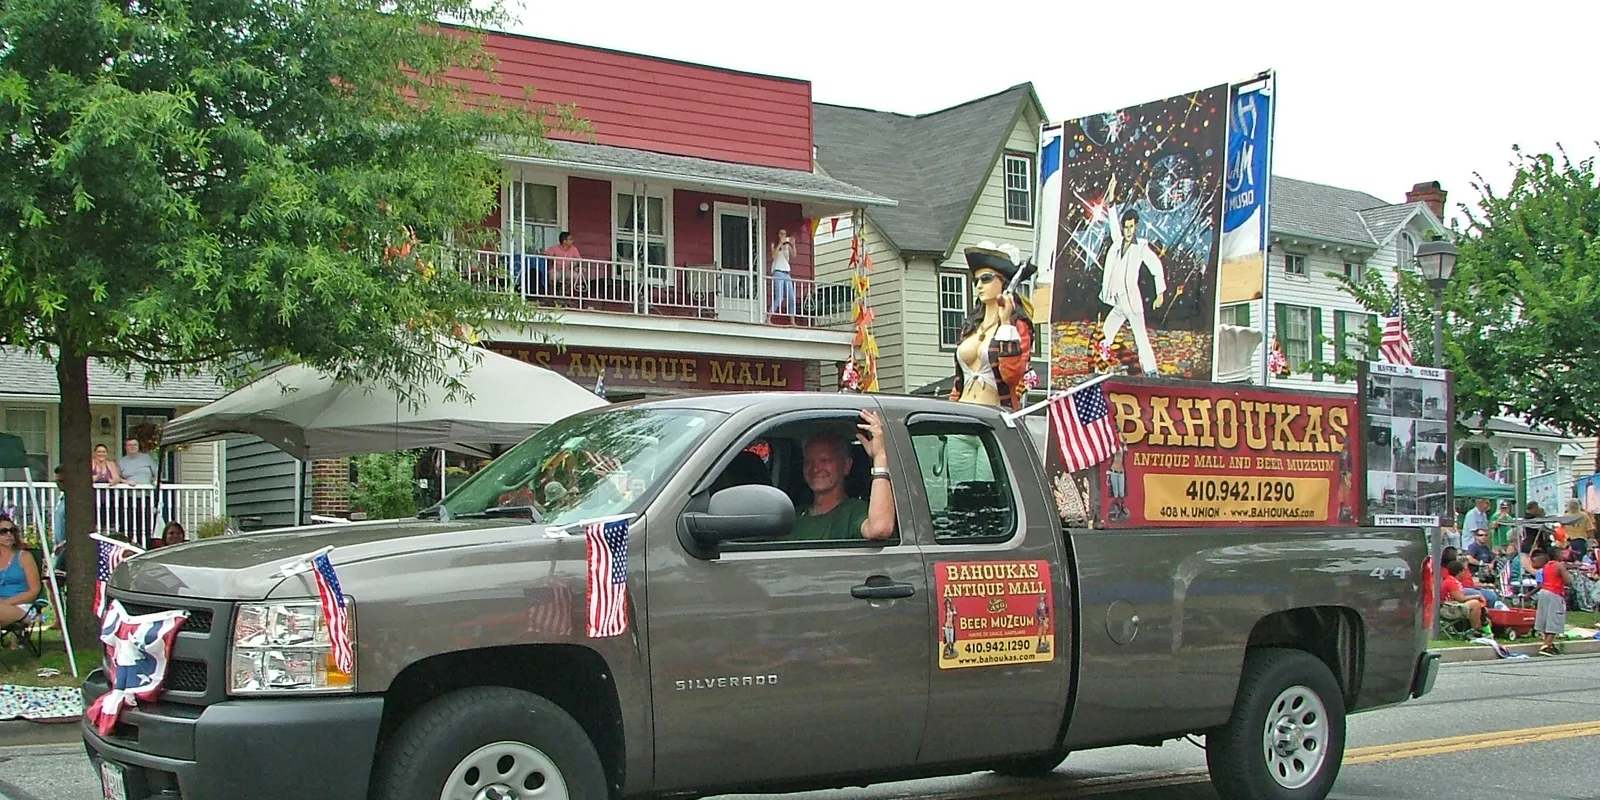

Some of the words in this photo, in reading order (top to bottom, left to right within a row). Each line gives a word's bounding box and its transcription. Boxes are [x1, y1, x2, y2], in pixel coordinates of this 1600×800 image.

[565, 352, 698, 383] ANTIQUE
[709, 359, 787, 388] MALL
[1109, 392, 1349, 452] BAHOUKAS
[1133, 453, 1189, 468] ANTIQUE
[1194, 454, 1224, 469] MALL
[1229, 455, 1252, 470] AND
[1256, 457, 1284, 471] BEER
[1286, 458, 1335, 473] MUZEUM
[1185, 480, 1295, 502] 410.942.1290
[1159, 506, 1179, 518] 408
[1180, 506, 1190, 518] N.
[1191, 506, 1220, 519] UNION
[946, 563, 1039, 580] BAHOUKAS
[943, 582, 1005, 598] ANTIQUE
[1008, 581, 1047, 595] MALL
[960, 616, 988, 630] BEER
[991, 614, 1034, 629] MUZEUM
[964, 640, 1031, 654] 410.942.1290
[958, 654, 1036, 664] www.bahoukas.com
[675, 674, 778, 690] SILVERADO
